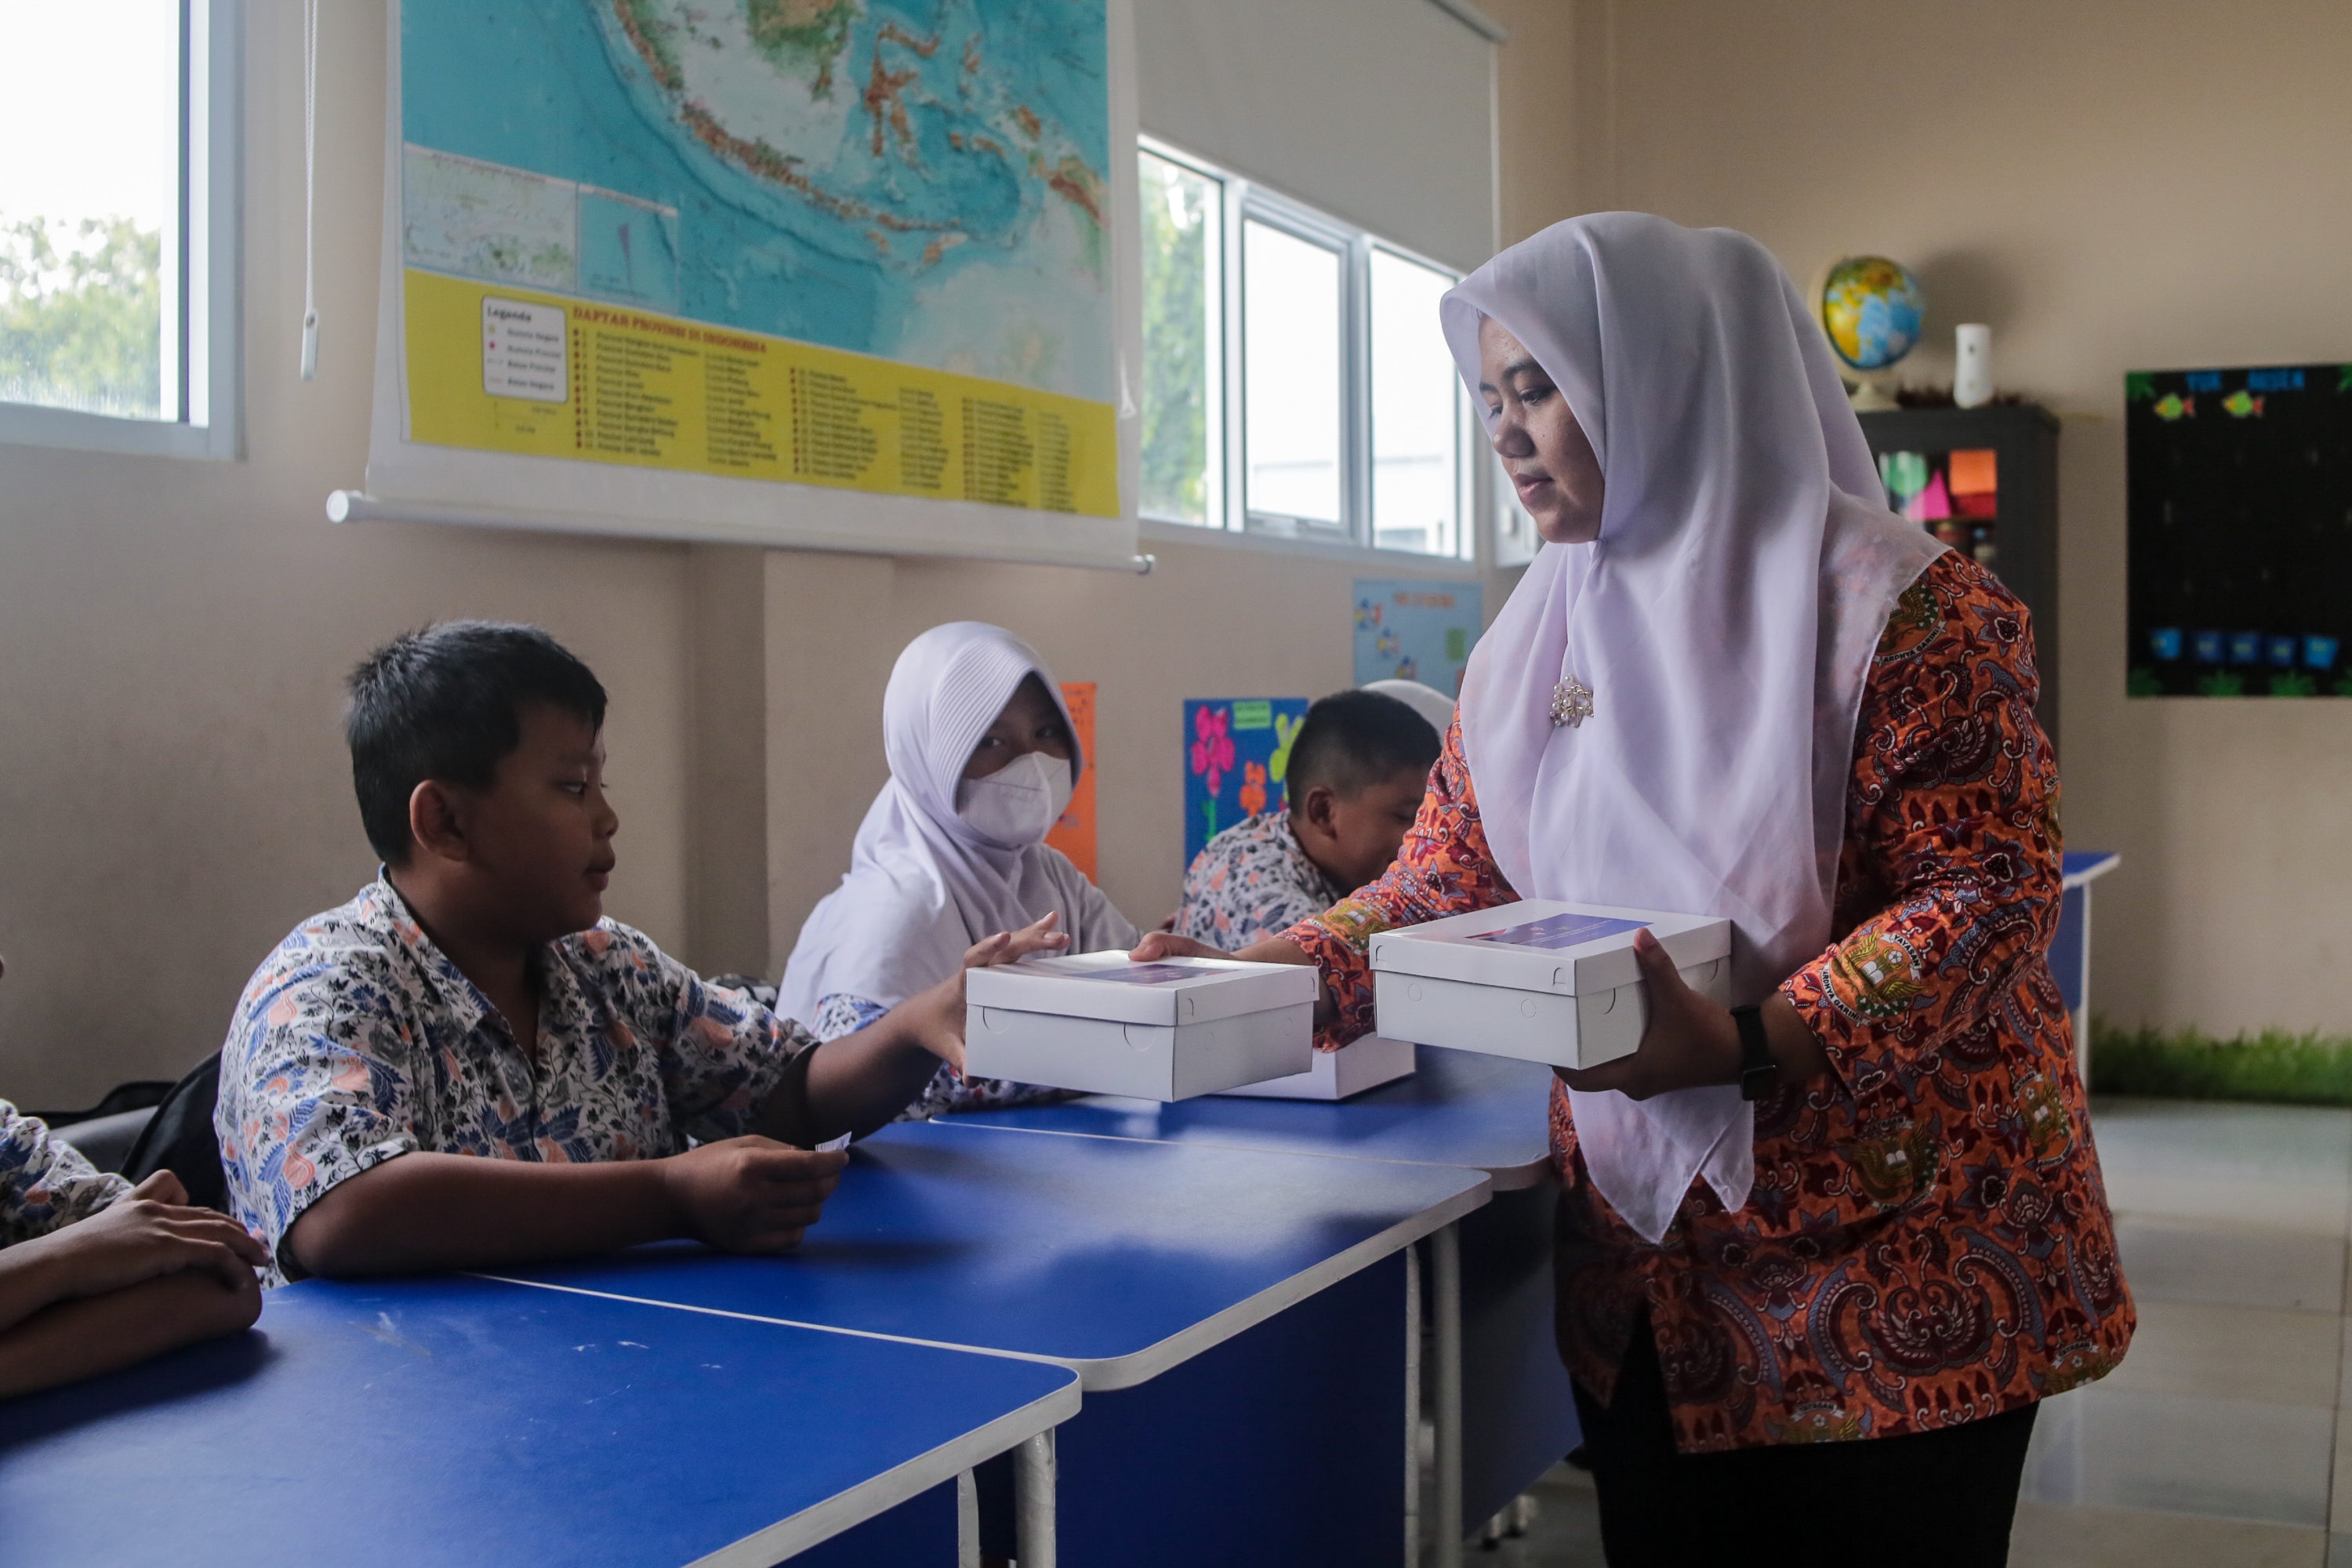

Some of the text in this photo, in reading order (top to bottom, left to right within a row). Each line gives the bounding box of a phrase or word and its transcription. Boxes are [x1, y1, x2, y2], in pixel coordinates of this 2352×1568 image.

[573, 307, 628, 326] DAFTAR
[1883, 629, 1940, 663] ARDHYA GARINI
[1894, 934, 1921, 967] YAYASAN
[1822, 971, 1860, 1021] ARDHYA GARINI
